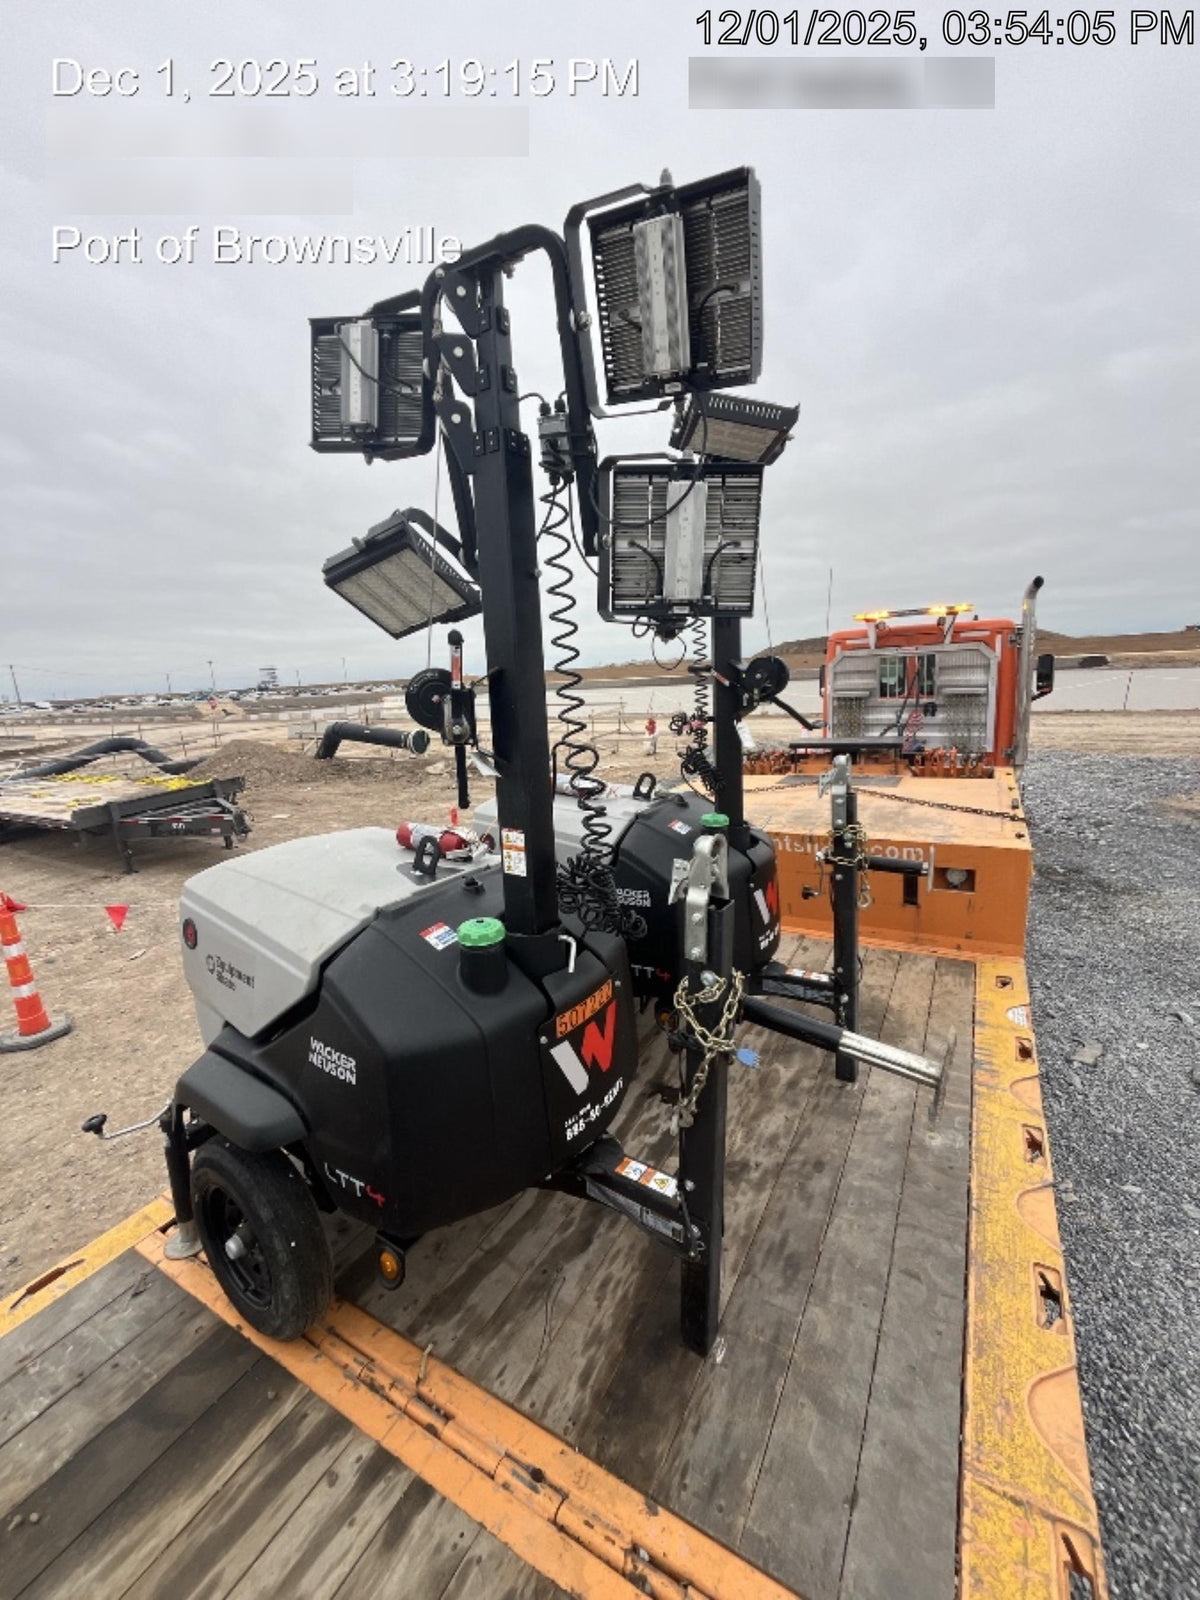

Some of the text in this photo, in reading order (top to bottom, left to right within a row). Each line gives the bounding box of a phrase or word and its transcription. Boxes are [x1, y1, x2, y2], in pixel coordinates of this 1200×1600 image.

[630, 963, 672, 983] TT4
[307, 1052, 358, 1086] NEUSON
[309, 1036, 357, 1074] WACKER
[322, 1161, 386, 1208] LTT4
